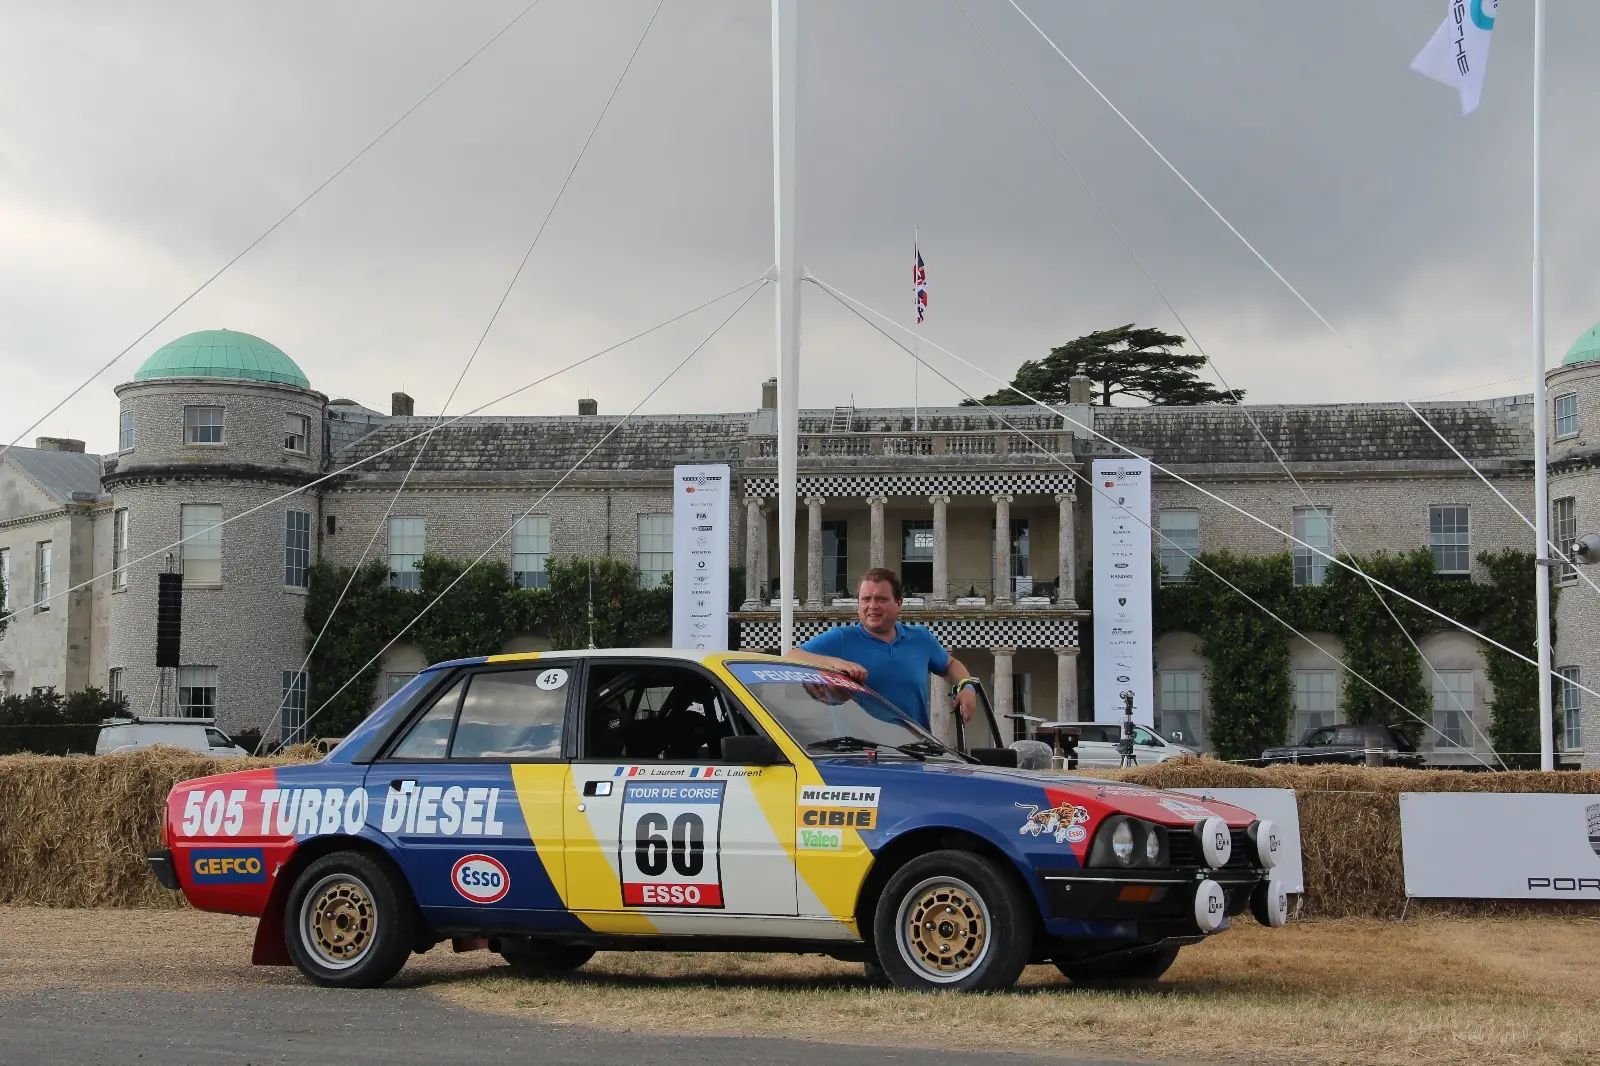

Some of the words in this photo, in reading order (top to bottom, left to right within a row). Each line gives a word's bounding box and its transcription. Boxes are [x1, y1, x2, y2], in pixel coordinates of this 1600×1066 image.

[543, 672, 558, 685] 45
[751, 670, 829, 684] PEUGEOT
[638, 768, 646, 776] D.
[650, 768, 685, 776] Laurent
[714, 769, 723, 777] C.
[727, 769, 763, 777] Laurent
[629, 788, 659, 798] TOUR
[661, 788, 677, 798] DE
[679, 788, 720, 798] CORSE
[802, 790, 876, 802] MICHELIN
[182, 790, 245, 837] 505
[260, 788, 369, 835] TURBO
[382, 785, 504, 835] DIESEL
[635, 812, 705, 877] 60
[801, 830, 839, 848] Valeo
[194, 857, 261, 875] GEFCO
[642, 886, 701, 904] ESSO
